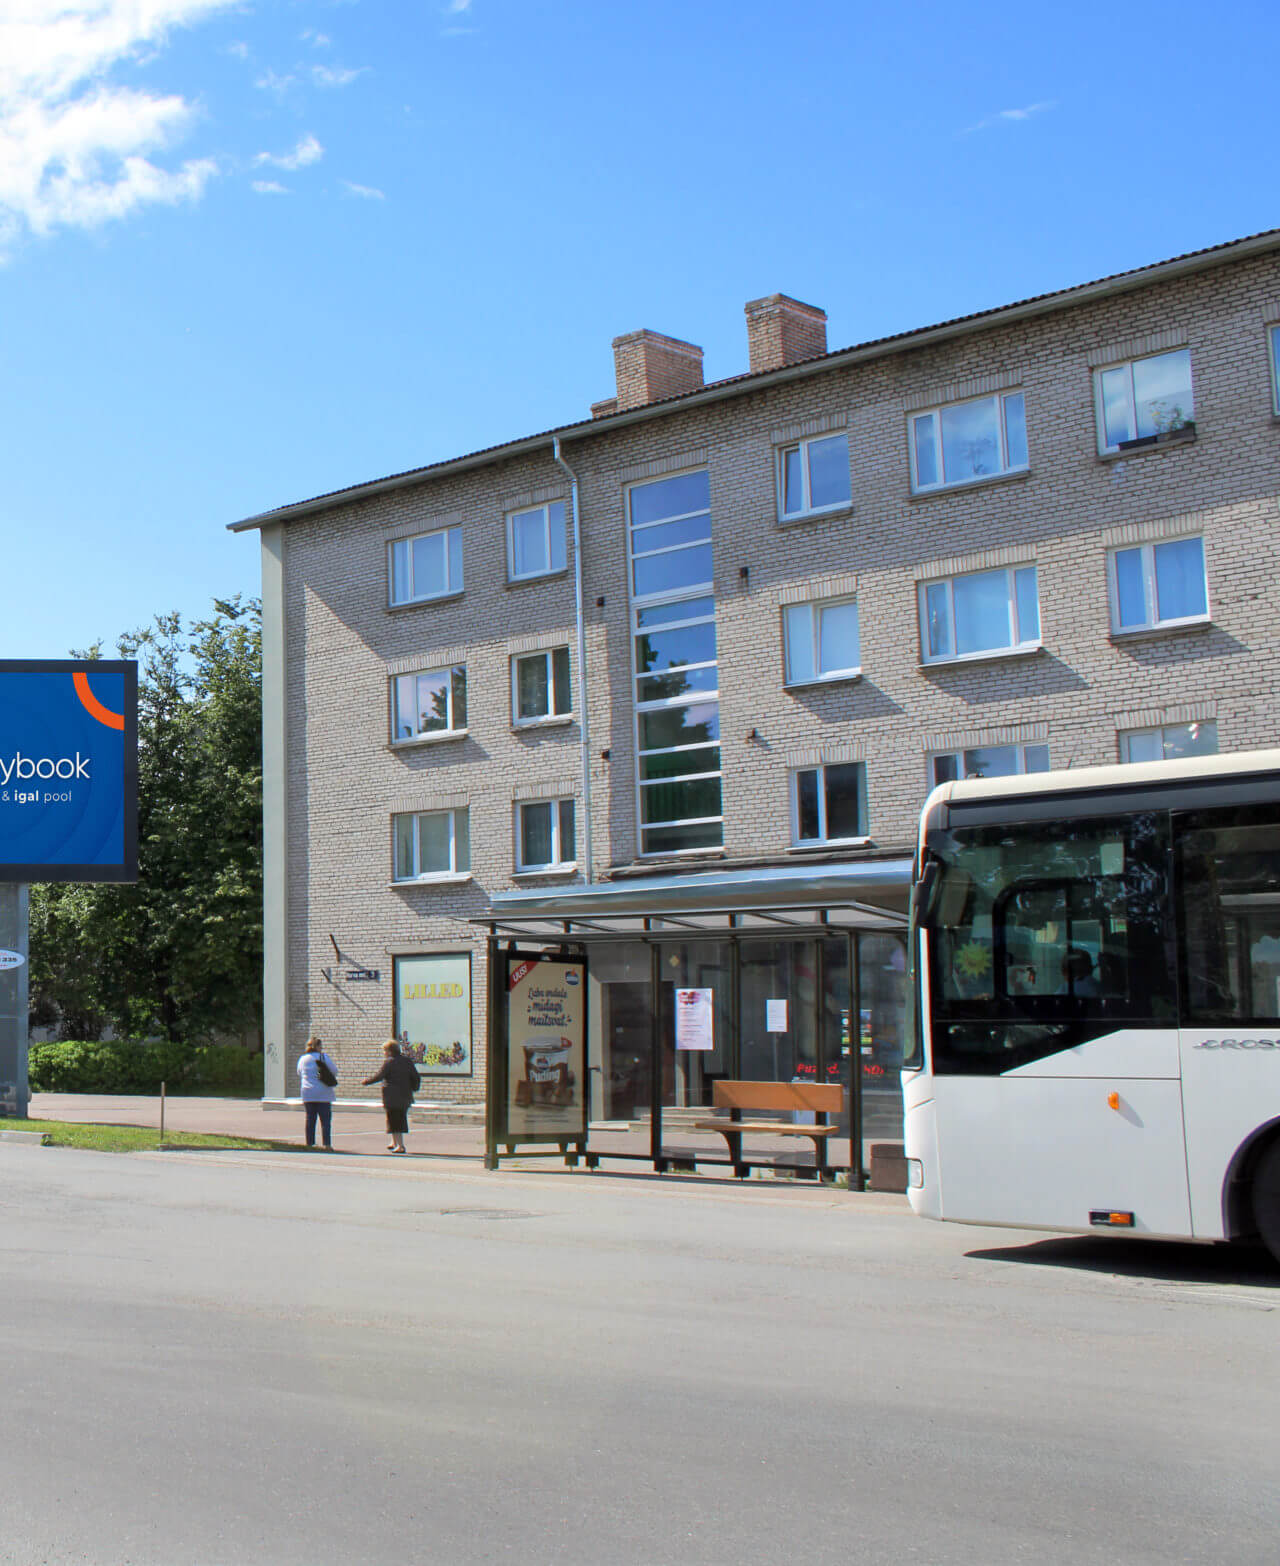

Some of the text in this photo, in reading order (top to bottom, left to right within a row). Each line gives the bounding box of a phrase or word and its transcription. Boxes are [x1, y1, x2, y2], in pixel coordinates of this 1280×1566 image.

[1, 790, 10, 802] &
[14, 789, 39, 804] igal
[44, 790, 72, 803] pool
[404, 983, 464, 999] LILLED
